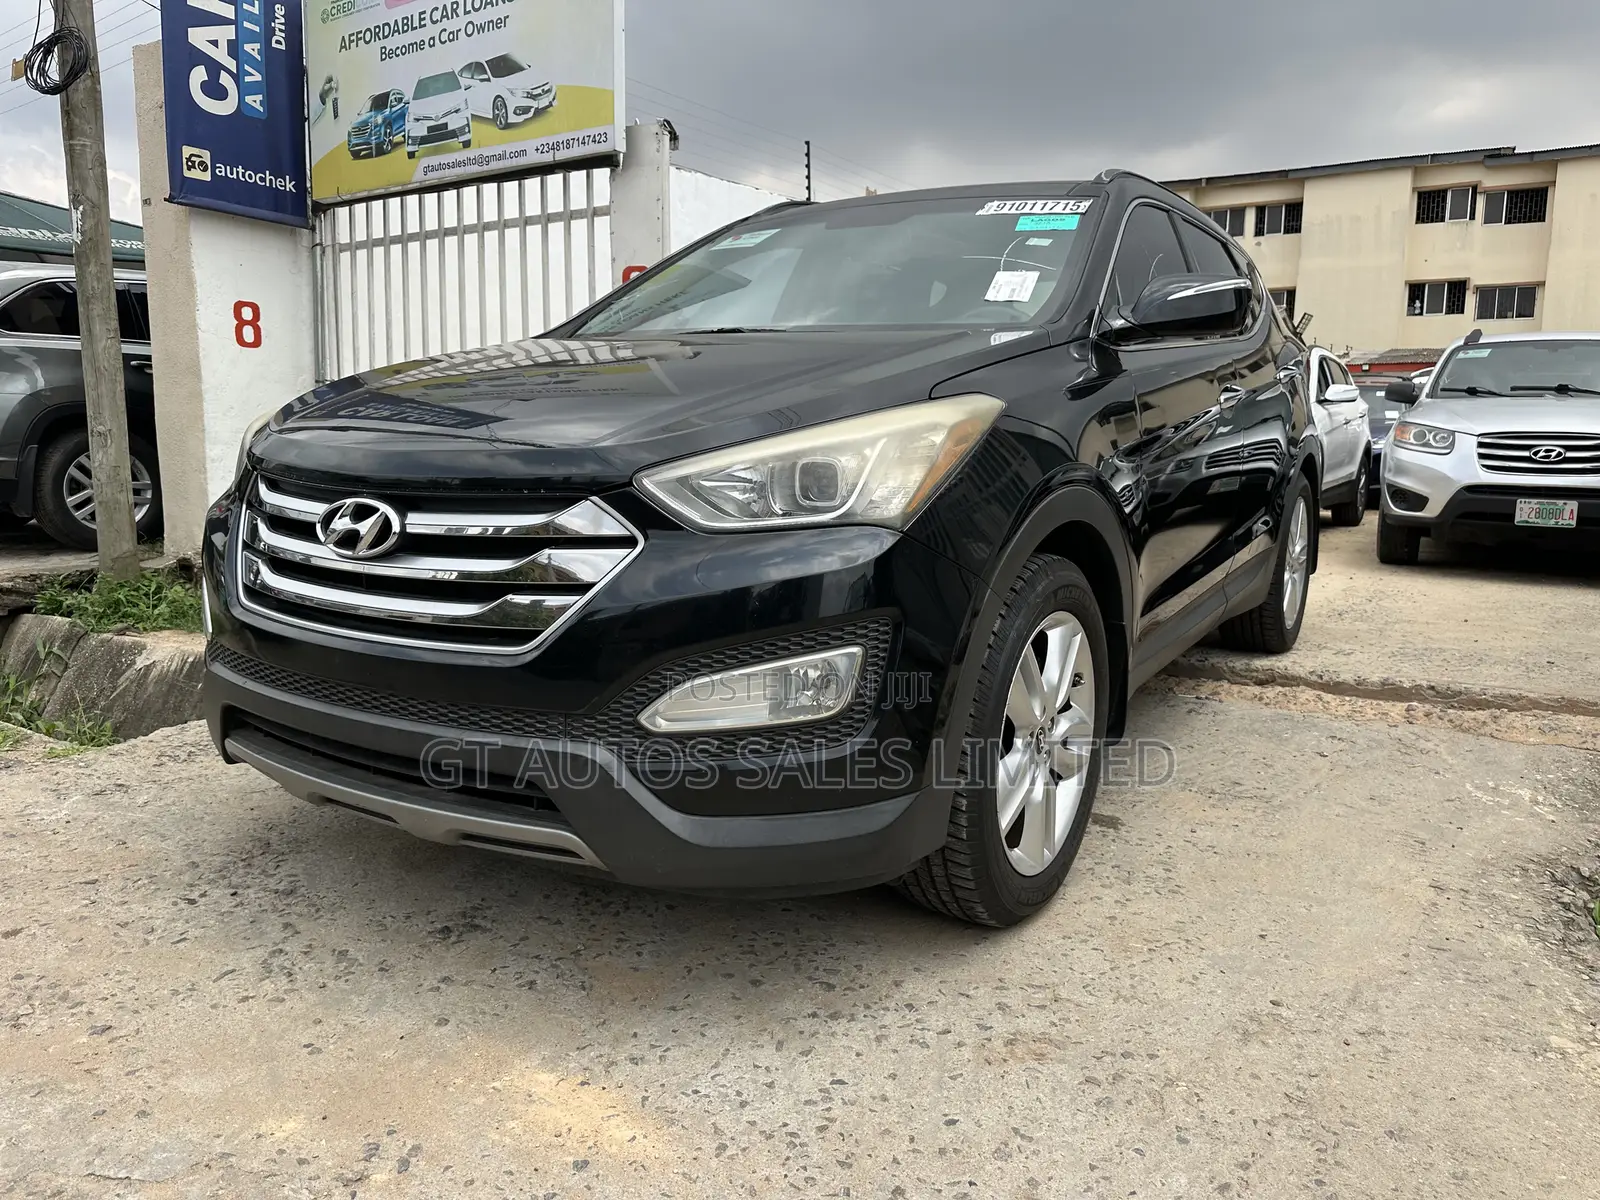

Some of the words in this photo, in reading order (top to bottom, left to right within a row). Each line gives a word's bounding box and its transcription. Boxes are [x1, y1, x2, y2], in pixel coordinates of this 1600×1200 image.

[271, 3, 286, 50] Drive
[338, 10, 427, 53] AFFORDABLE
[429, 1, 460, 26] CAR
[463, 0, 515, 16] LOA
[379, 36, 426, 62] Become
[428, 36, 436, 48] a
[438, 26, 462, 45] Car
[464, 14, 510, 38] Owner
[422, 147, 528, 176] gtautosalesltd@gmail.com
[534, 131, 608, 155] +2348187147423
[215, 163, 297, 193] autochek
[993, 201, 1083, 212] 91011715
[232, 299, 262, 349] 8
